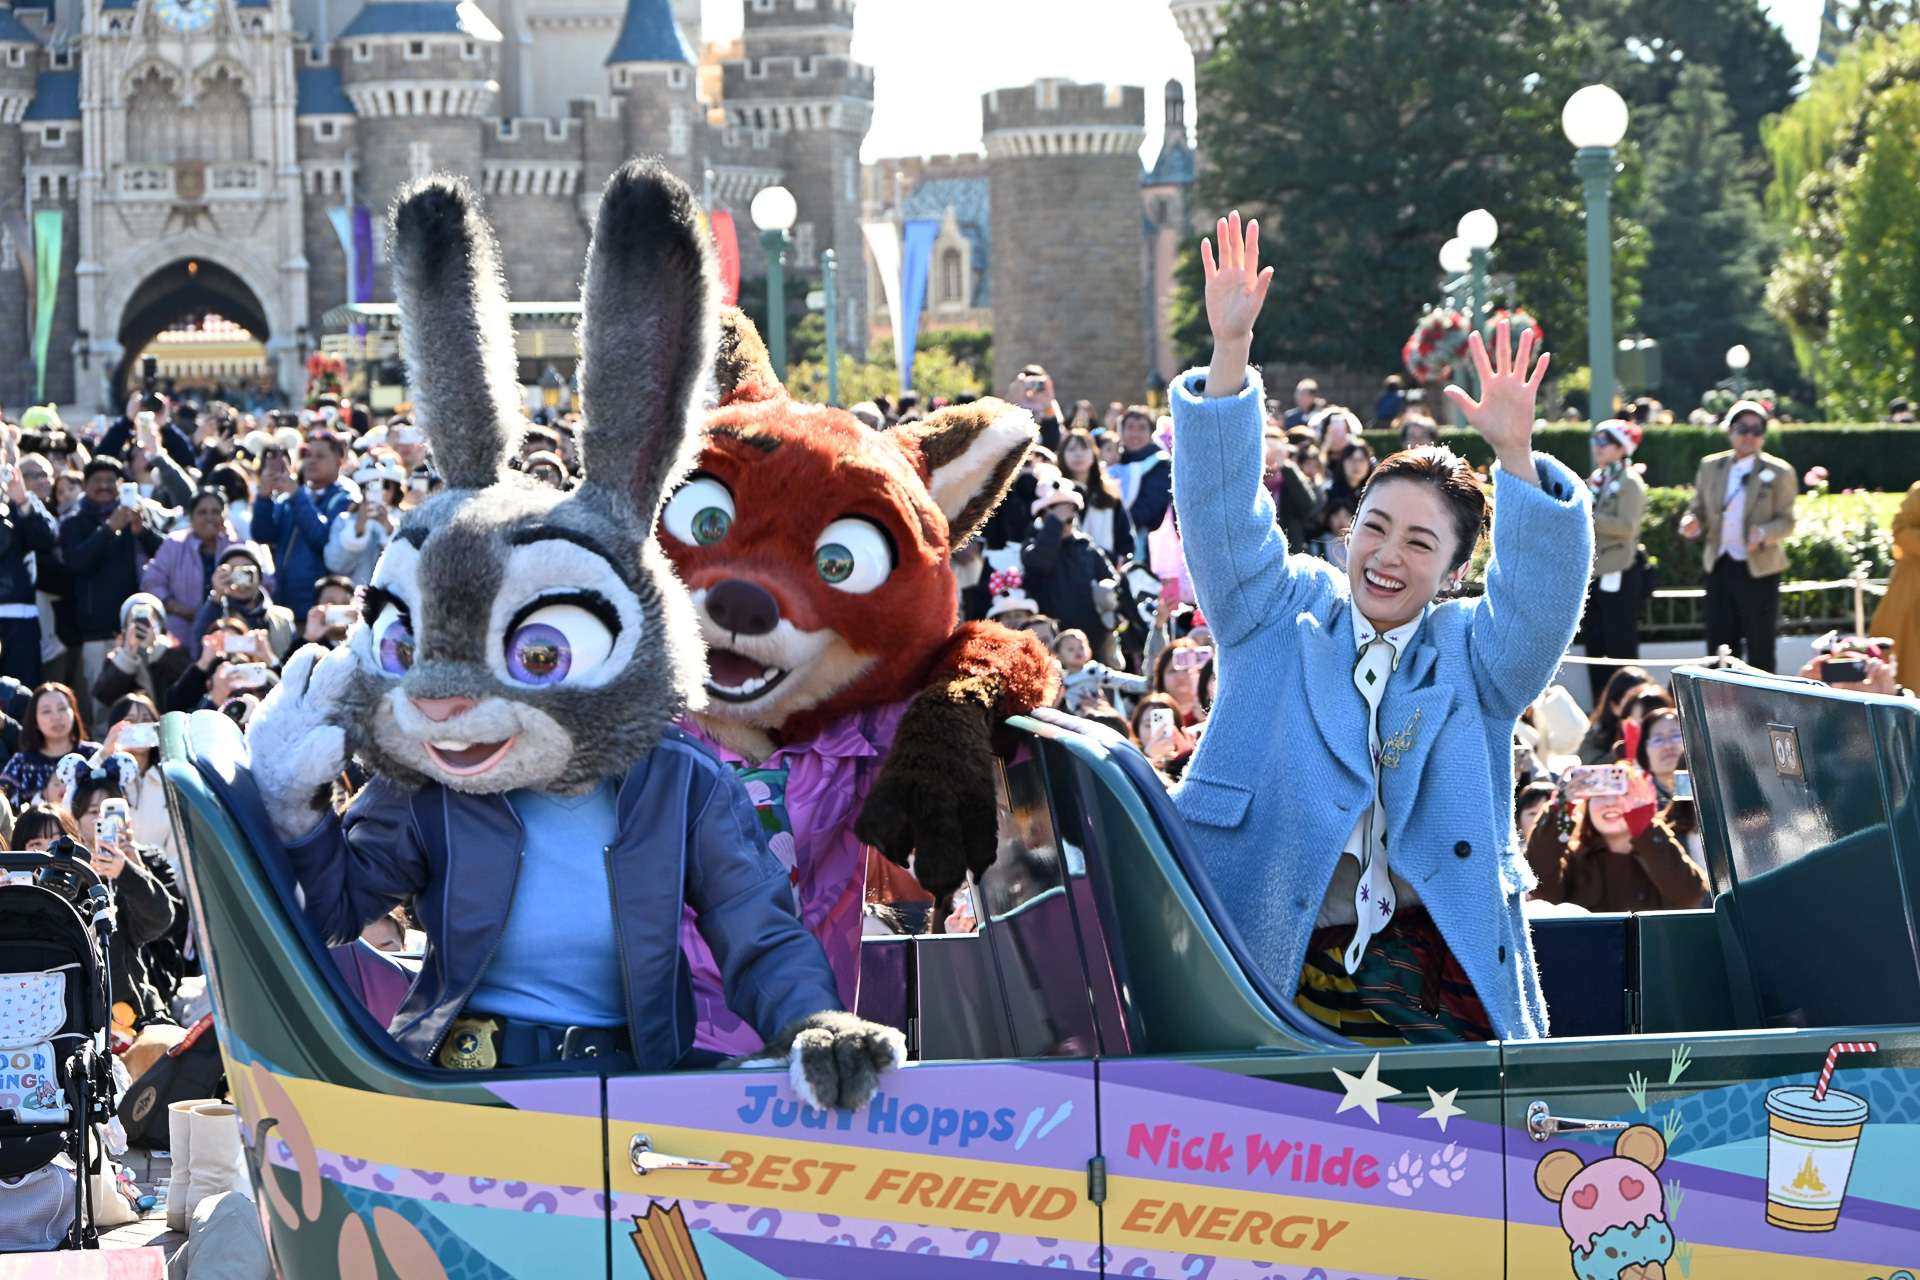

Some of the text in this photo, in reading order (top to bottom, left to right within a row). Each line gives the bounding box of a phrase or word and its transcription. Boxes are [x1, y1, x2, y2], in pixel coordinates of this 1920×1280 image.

[449, 1057, 483, 1068] POLICE
[867, 1092, 1016, 1148] Hopps
[1126, 1122, 1380, 1189] Nick Wilde
[708, 1150, 1349, 1251] BEST FRIEND ENERGY
